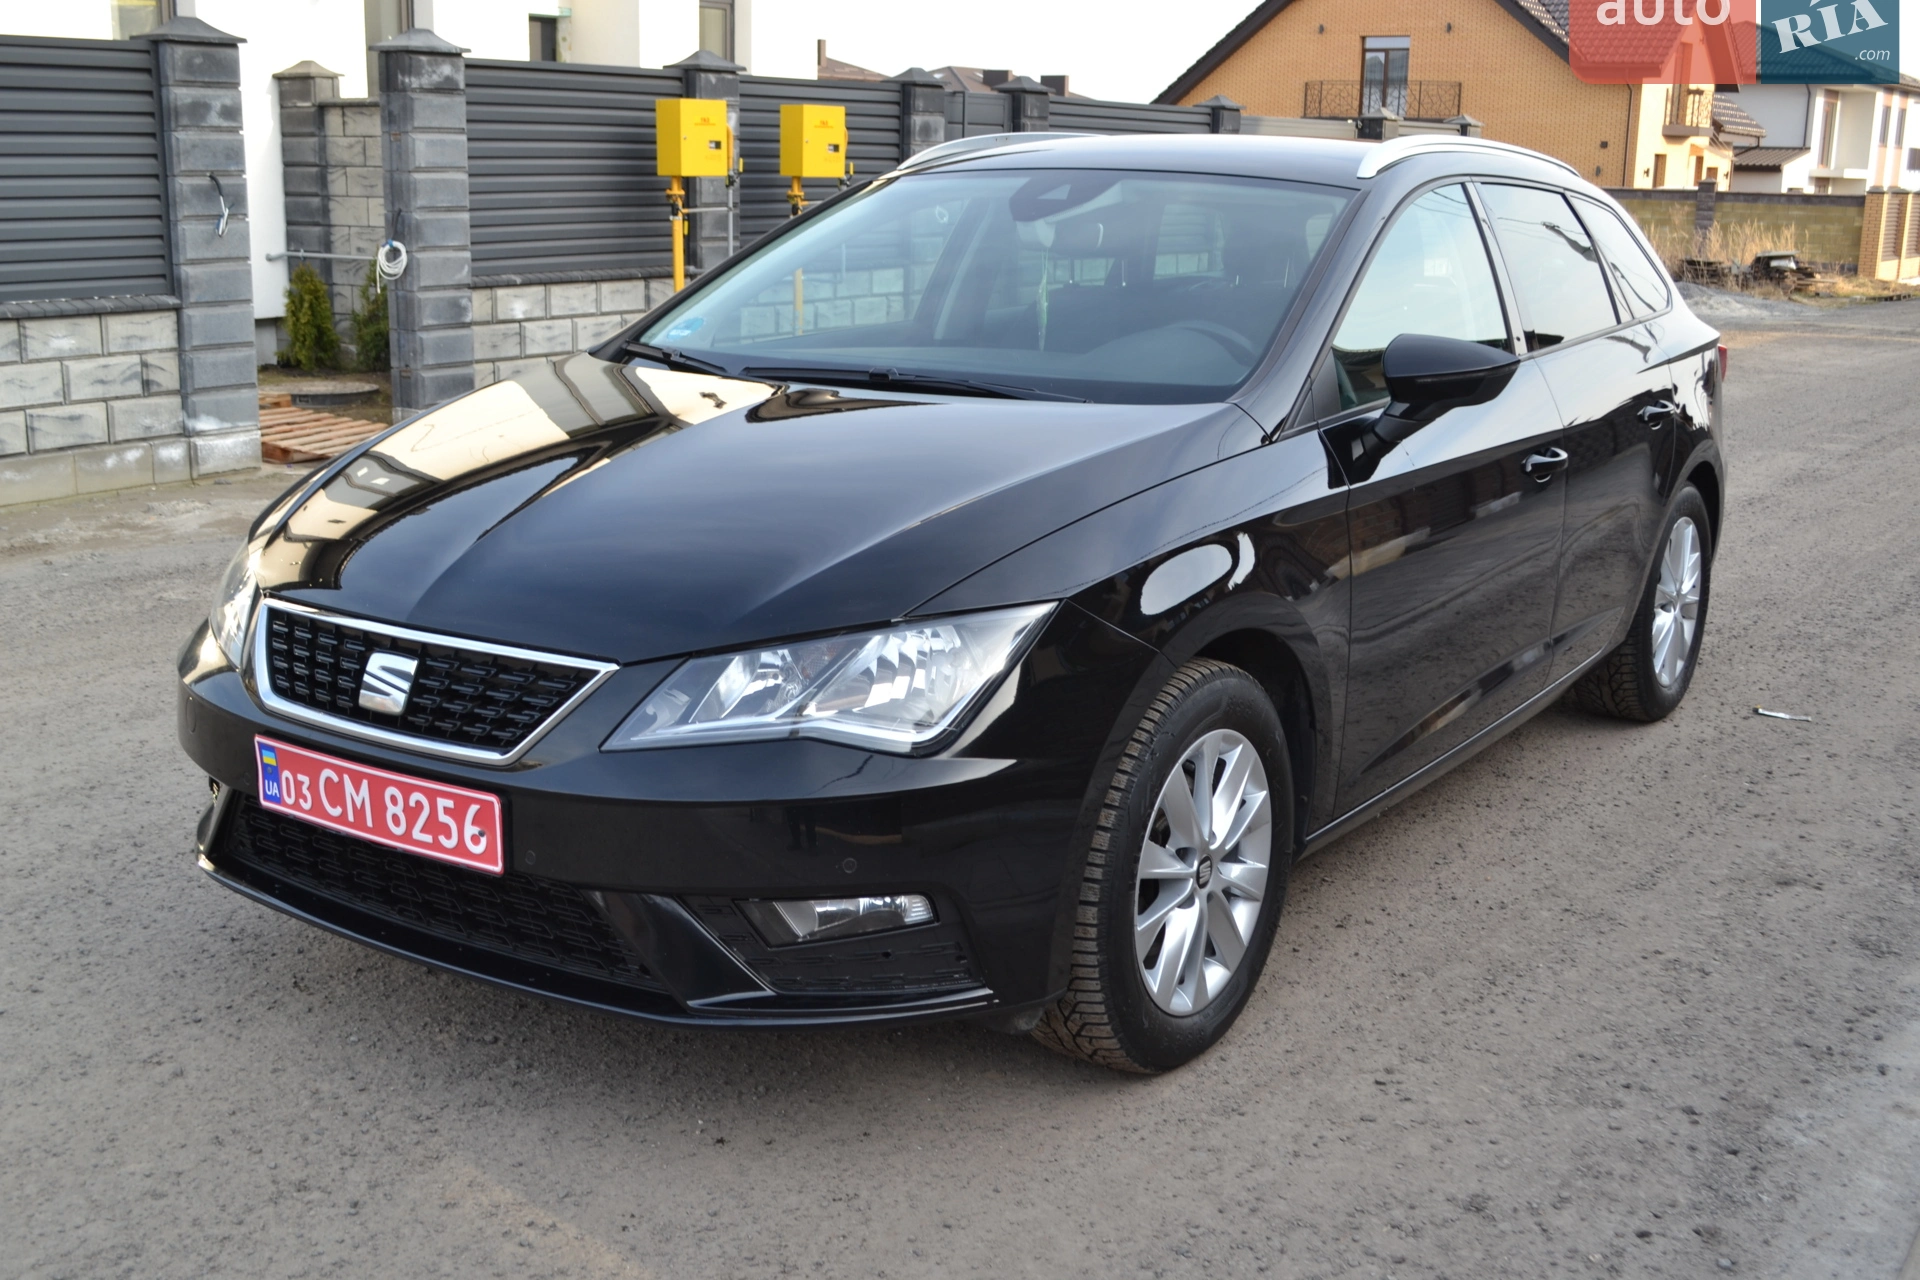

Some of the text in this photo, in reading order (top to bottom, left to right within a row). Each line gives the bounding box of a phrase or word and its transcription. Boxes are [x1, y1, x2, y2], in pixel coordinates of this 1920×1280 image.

[264, 779, 280, 798] UA
[281, 768, 487, 855] 03 CM 8256
